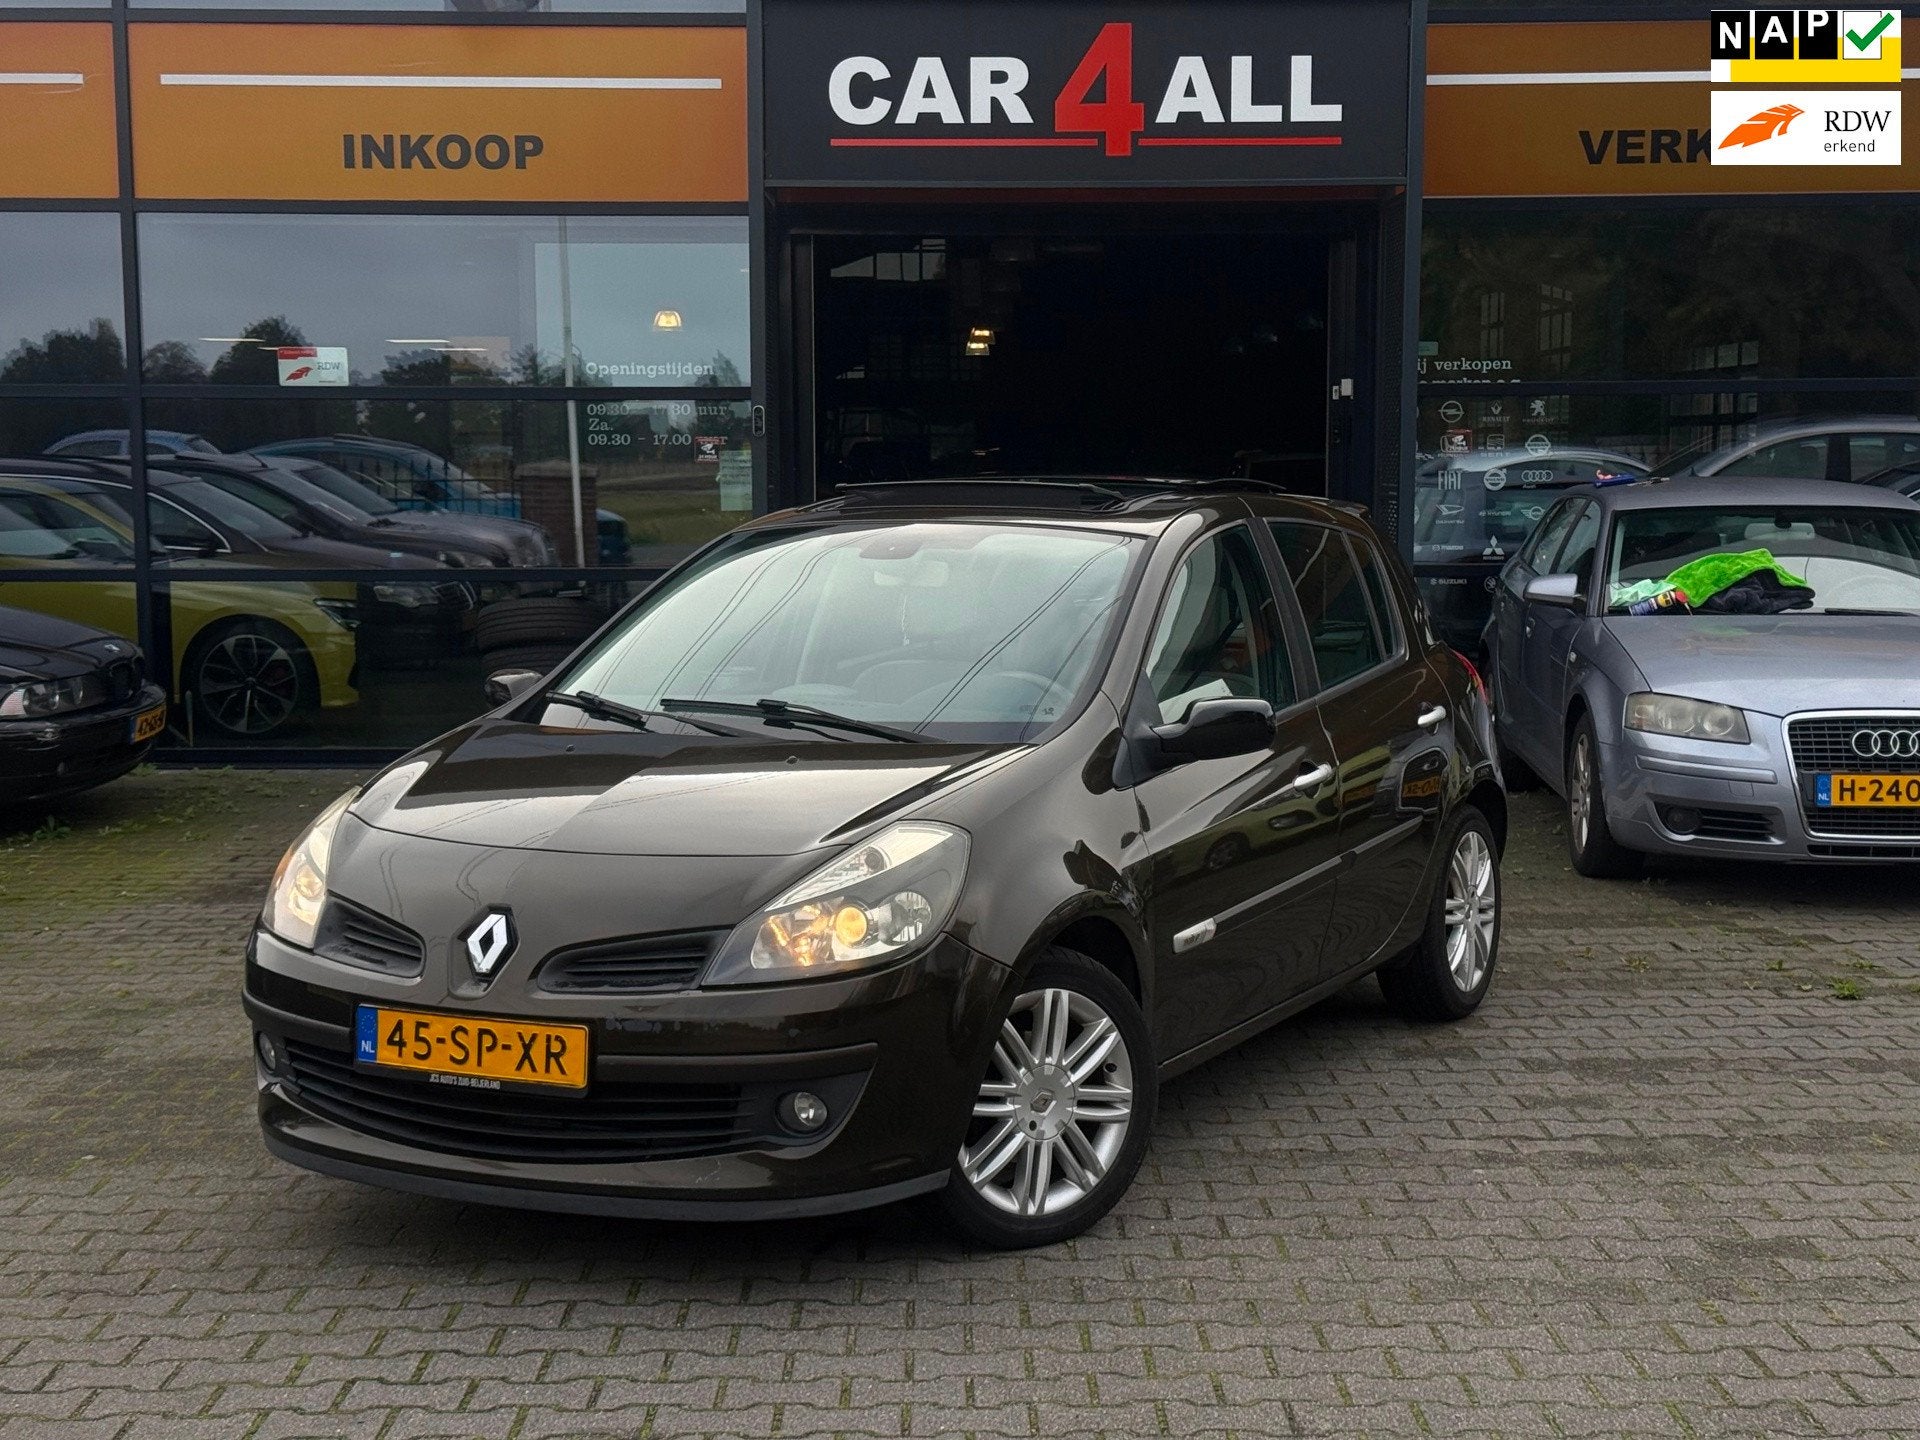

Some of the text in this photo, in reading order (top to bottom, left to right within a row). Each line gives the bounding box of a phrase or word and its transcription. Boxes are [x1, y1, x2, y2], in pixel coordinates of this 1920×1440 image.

[828, 22, 1343, 156] CAR 4 ALL
[342, 133, 544, 170] INKOOP
[1578, 129, 1711, 165] VERK
[317, 361, 341, 371] RDW
[585, 362, 715, 378] Openingstijden
[1434, 357, 1512, 373] verkopen
[699, 405, 728, 415] uur
[588, 418, 614, 431] Za.
[587, 434, 631, 446] 09.30
[653, 434, 692, 446] 17.00
[1438, 470, 1462, 490] FIAT
[1818, 793, 1829, 801] NL
[361, 1018, 568, 1076] NL 45-SP-XR
